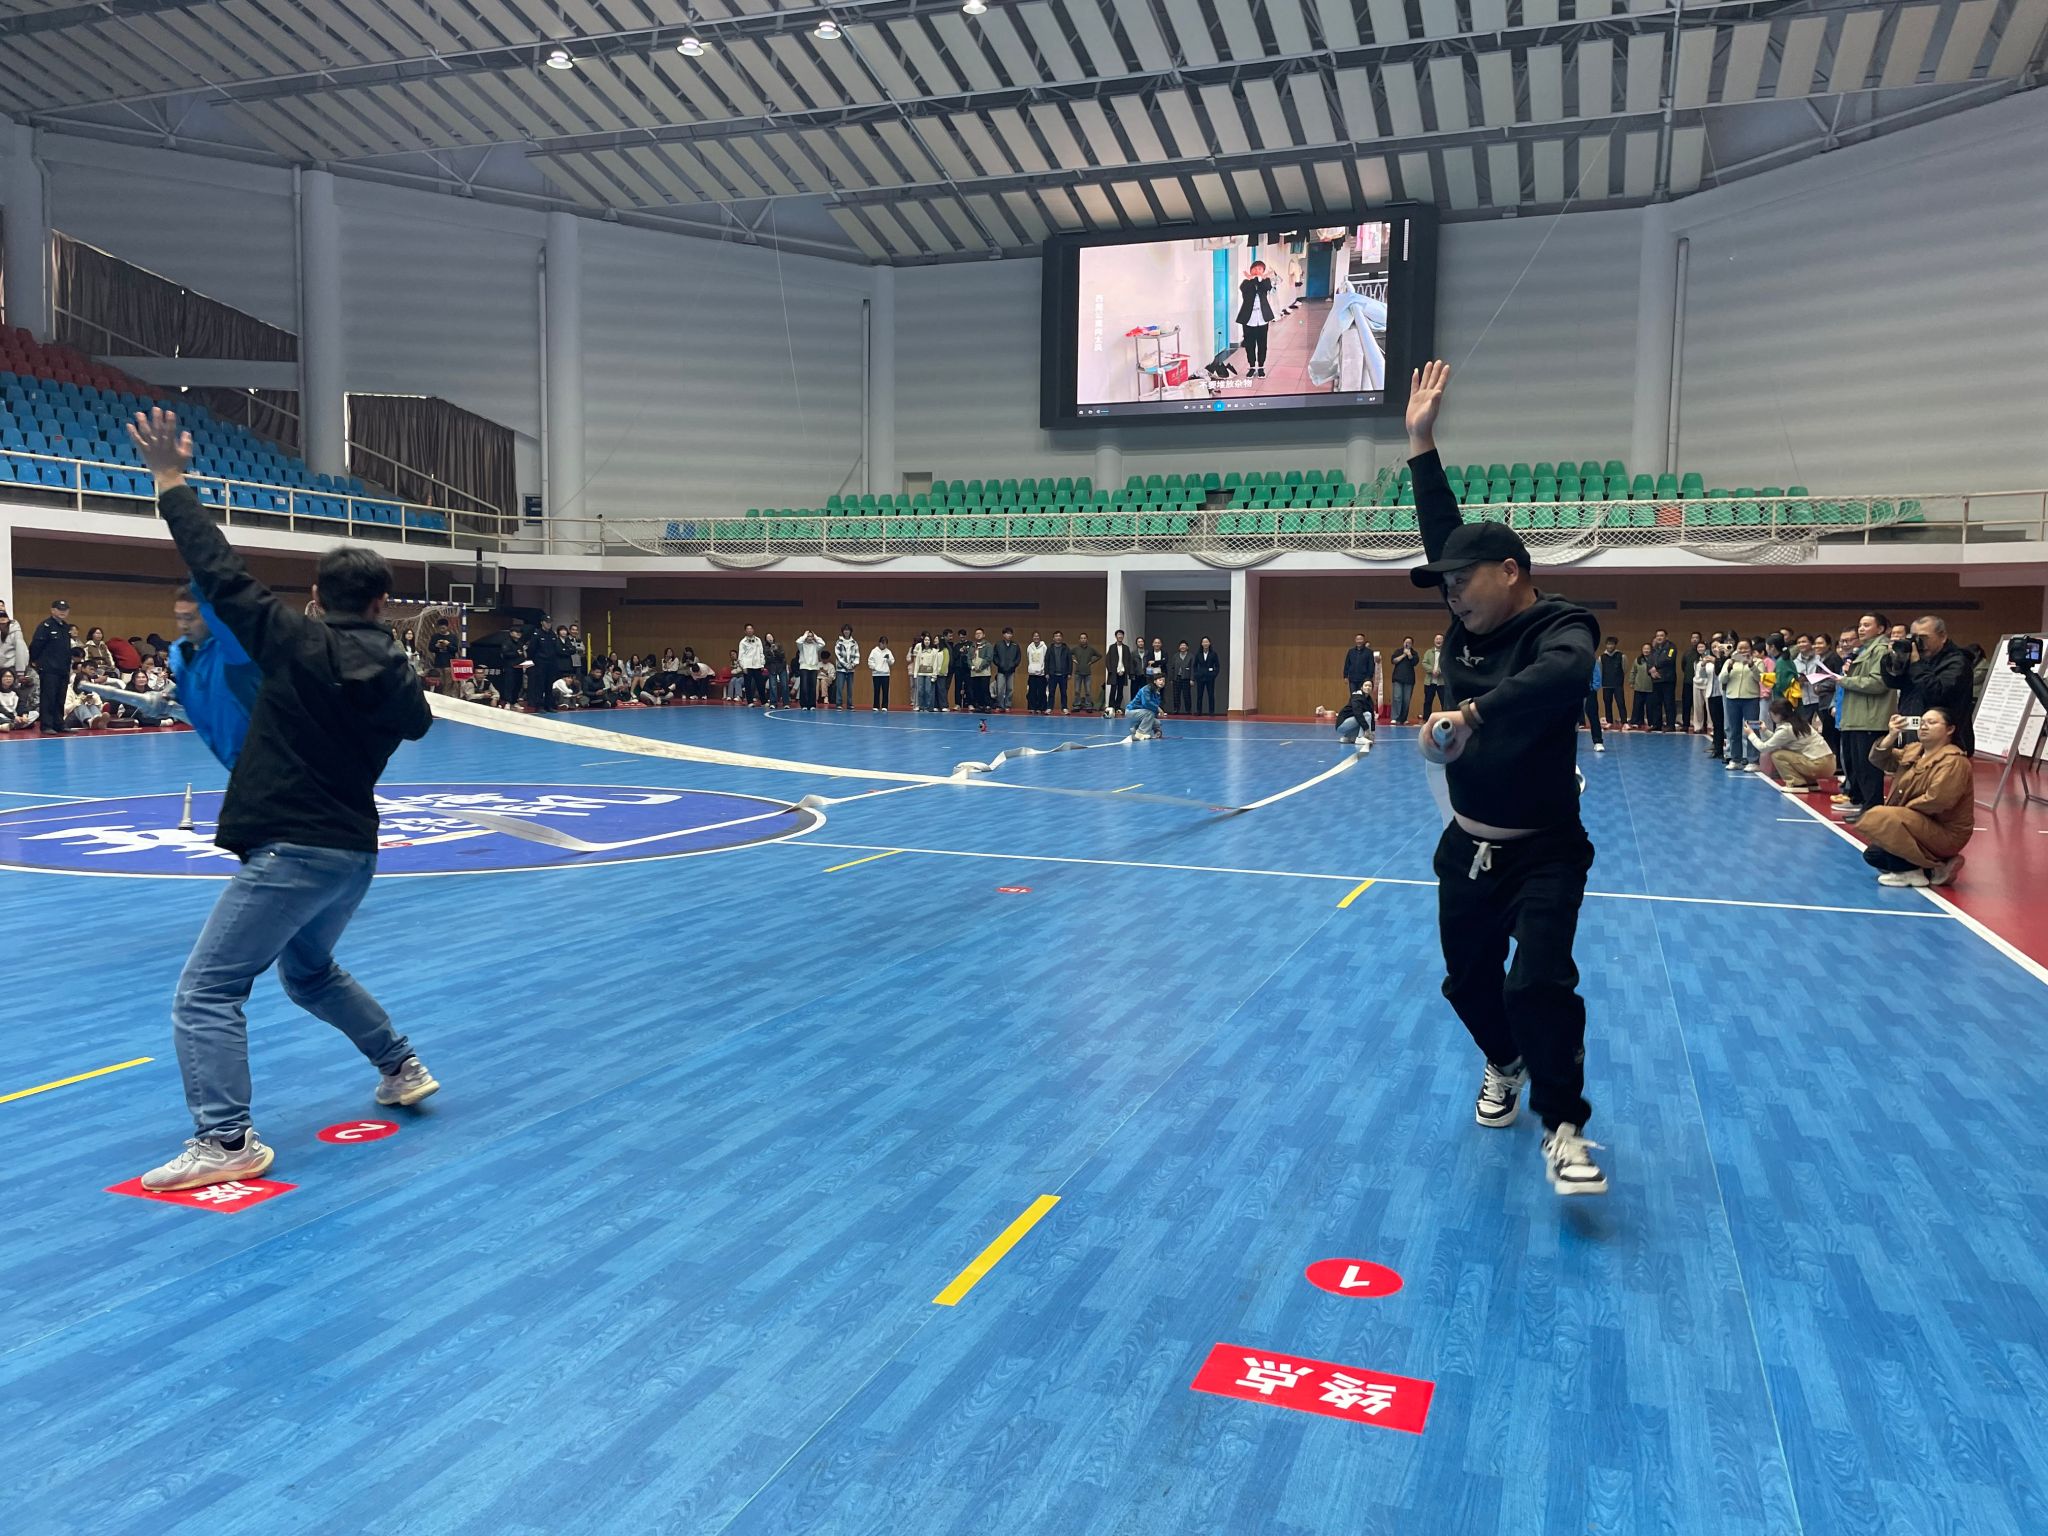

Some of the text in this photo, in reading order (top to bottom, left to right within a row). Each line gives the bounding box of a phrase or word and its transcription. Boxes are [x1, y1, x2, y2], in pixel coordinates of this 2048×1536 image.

[1198, 379, 1253, 390] 不要堆放杂物
[335, 1123, 387, 1140] 2
[1339, 1264, 1370, 1289] 1
[1235, 1357, 1397, 1416] 终点
